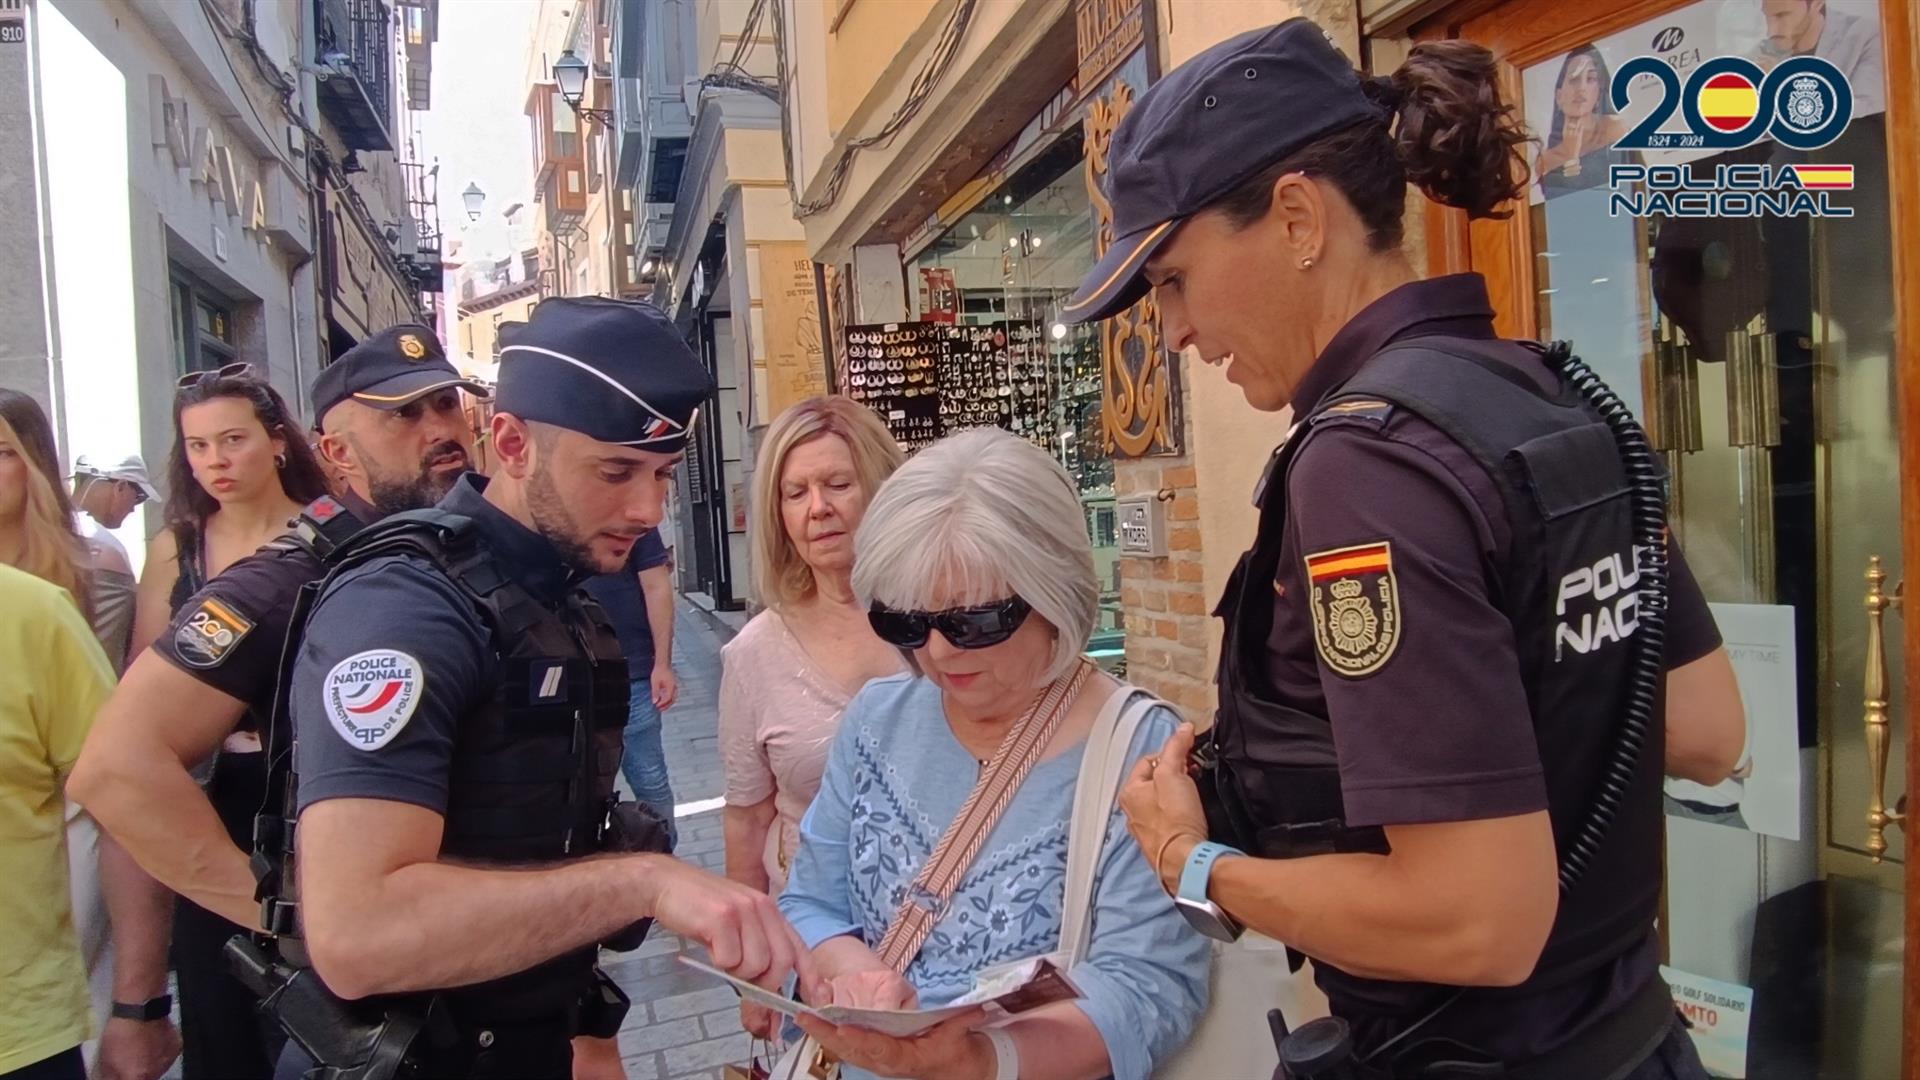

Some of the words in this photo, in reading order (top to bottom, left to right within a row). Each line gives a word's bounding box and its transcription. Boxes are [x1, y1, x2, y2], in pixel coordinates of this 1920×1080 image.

[1, 26, 24, 42] 910
[1556, 543, 1650, 616] POLI
[1554, 591, 1641, 663] NAC
[350, 656, 397, 672] POLICE
[333, 668, 412, 685] NATIONALE
[383, 716, 398, 731] DE
[394, 681, 413, 716] POLICE
[1703, 991, 1745, 1013] SOLIDARIO
